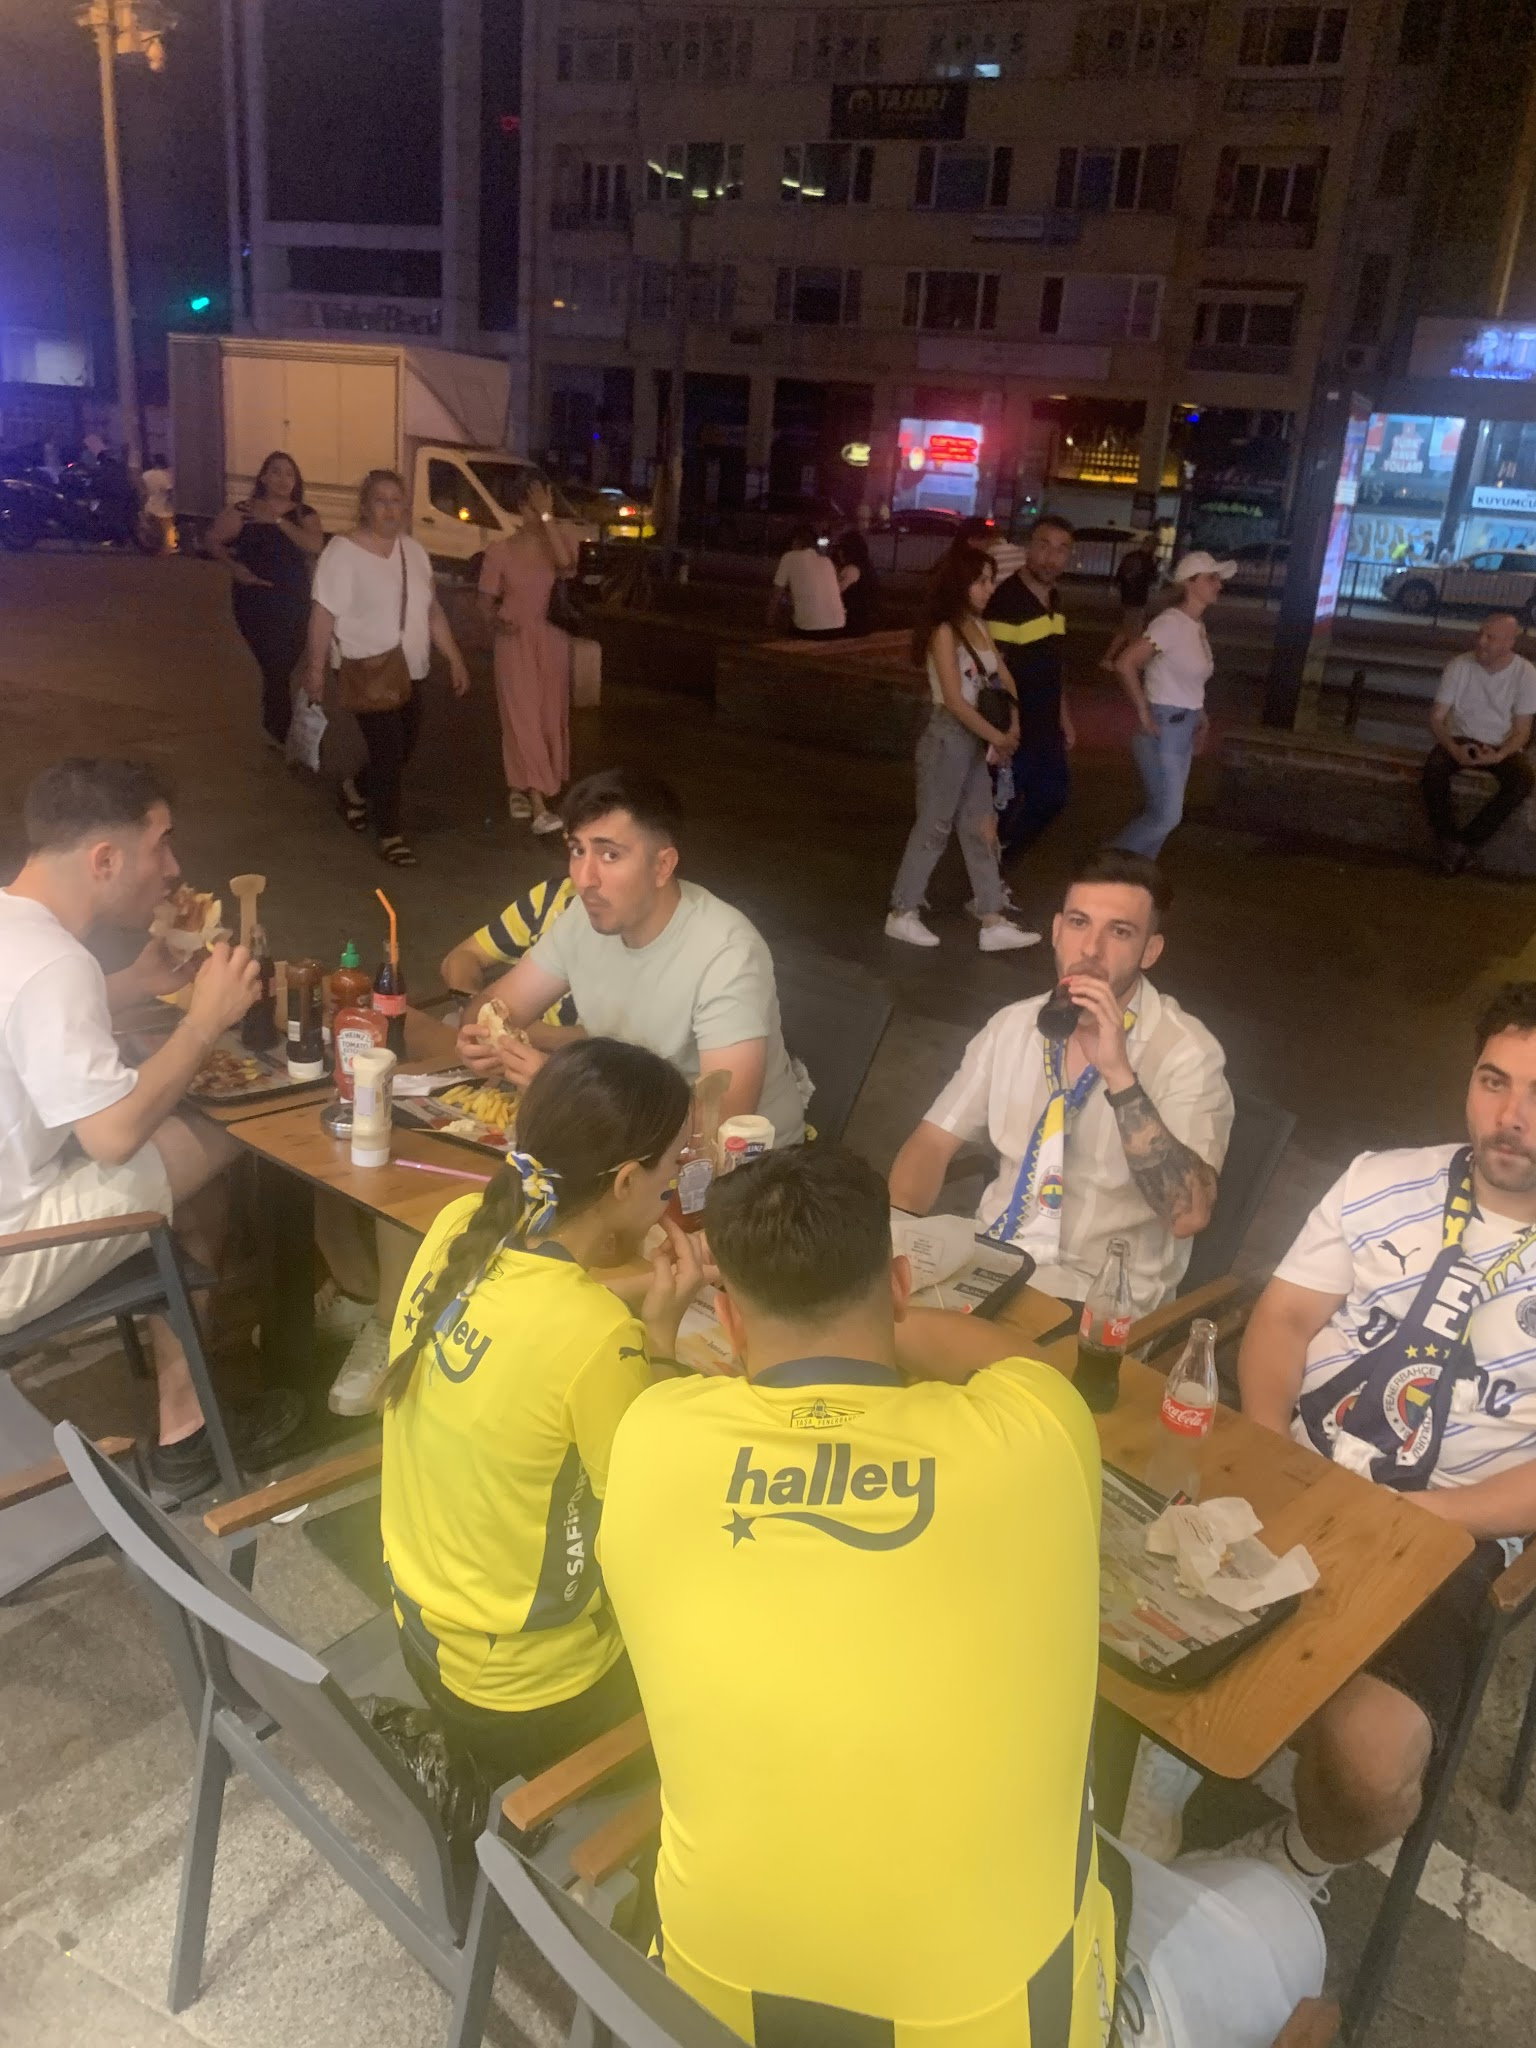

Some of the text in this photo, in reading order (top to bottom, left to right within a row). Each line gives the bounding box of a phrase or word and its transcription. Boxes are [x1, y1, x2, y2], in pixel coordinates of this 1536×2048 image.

[342, 1040, 369, 1049] TOMATO
[344, 1031, 365, 1040] HEINZ
[1385, 1366, 1437, 1412] FENERBAHÇE
[1162, 1399, 1204, 1427] Coca-Cola
[725, 1443, 936, 1551] halley
